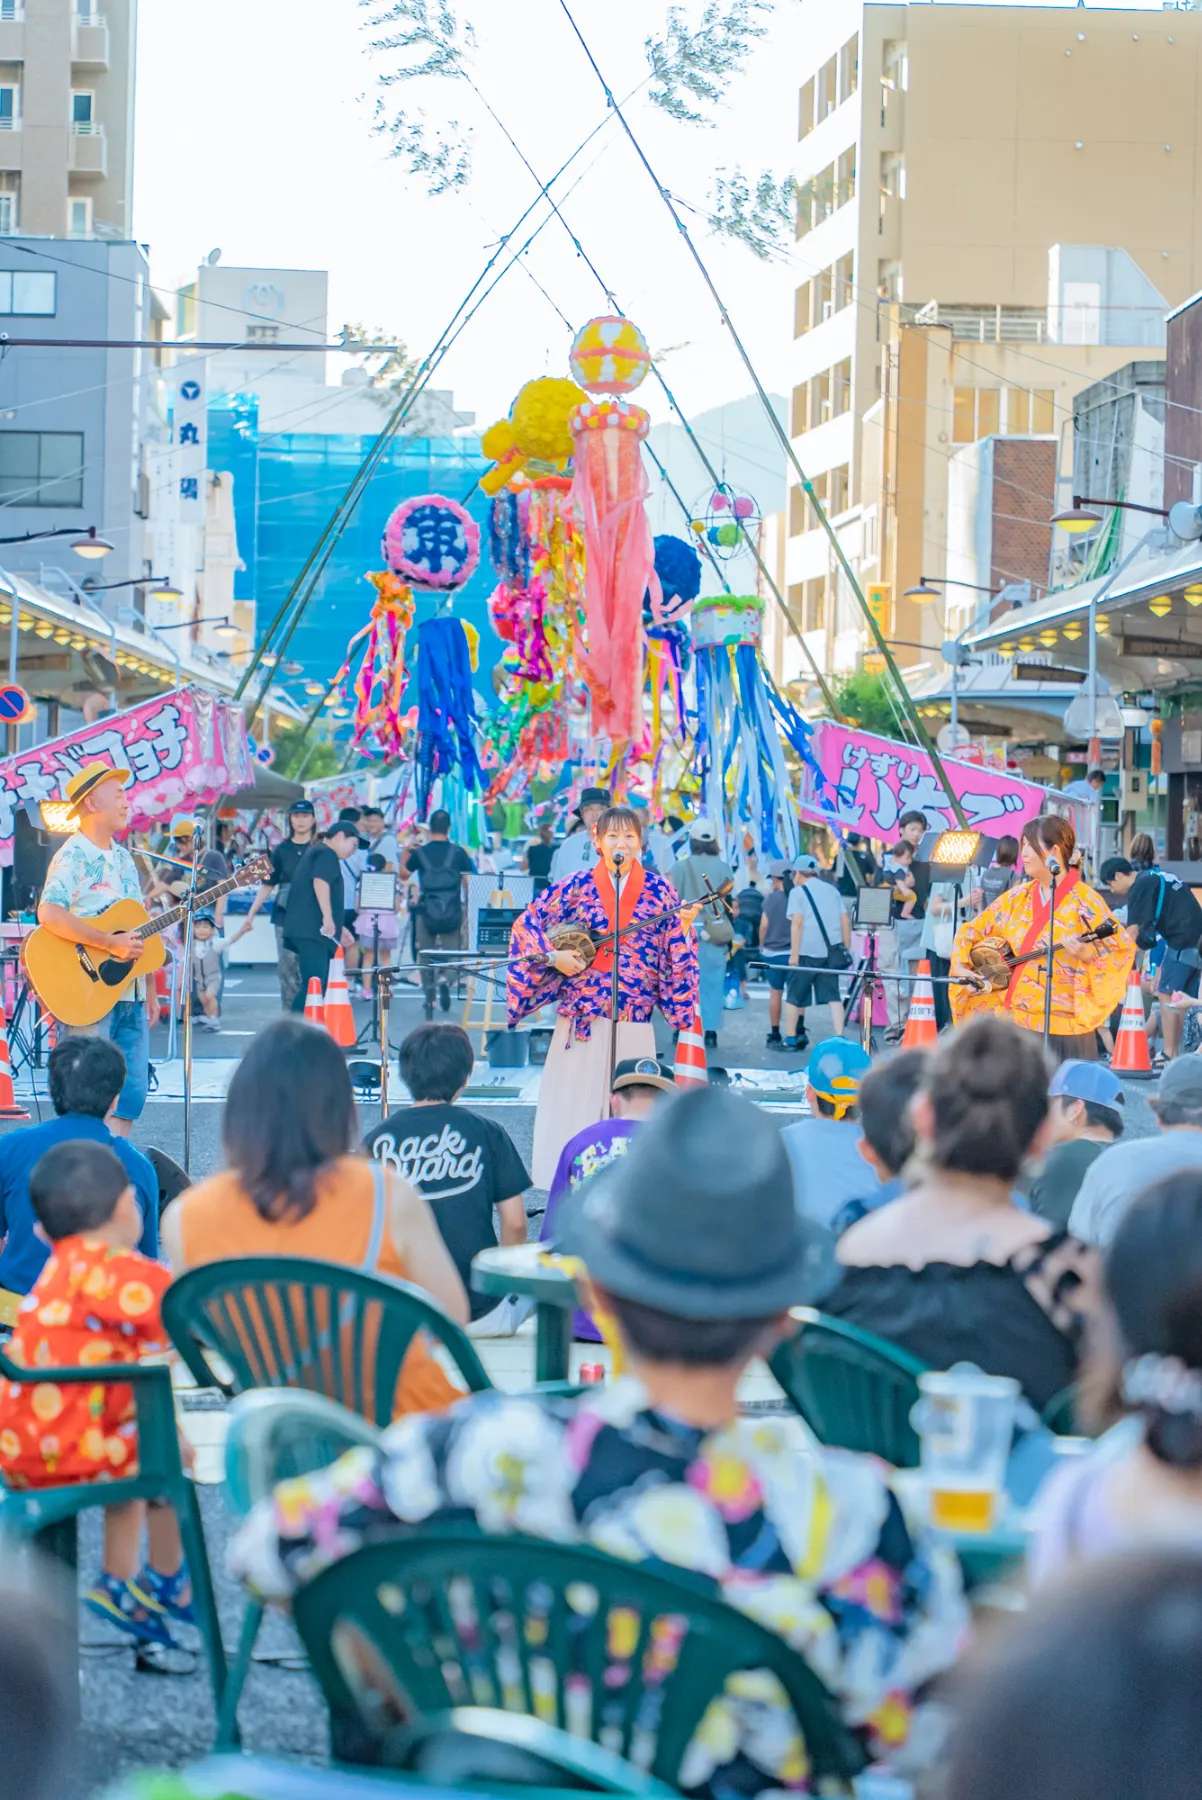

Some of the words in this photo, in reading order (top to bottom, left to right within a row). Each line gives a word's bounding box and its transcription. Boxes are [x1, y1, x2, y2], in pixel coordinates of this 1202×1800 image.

[841, 743, 921, 787] けずり
[837, 767, 1025, 833] いちご
[373, 1123, 467, 1174] Back
[401, 1145, 484, 1189] yard
